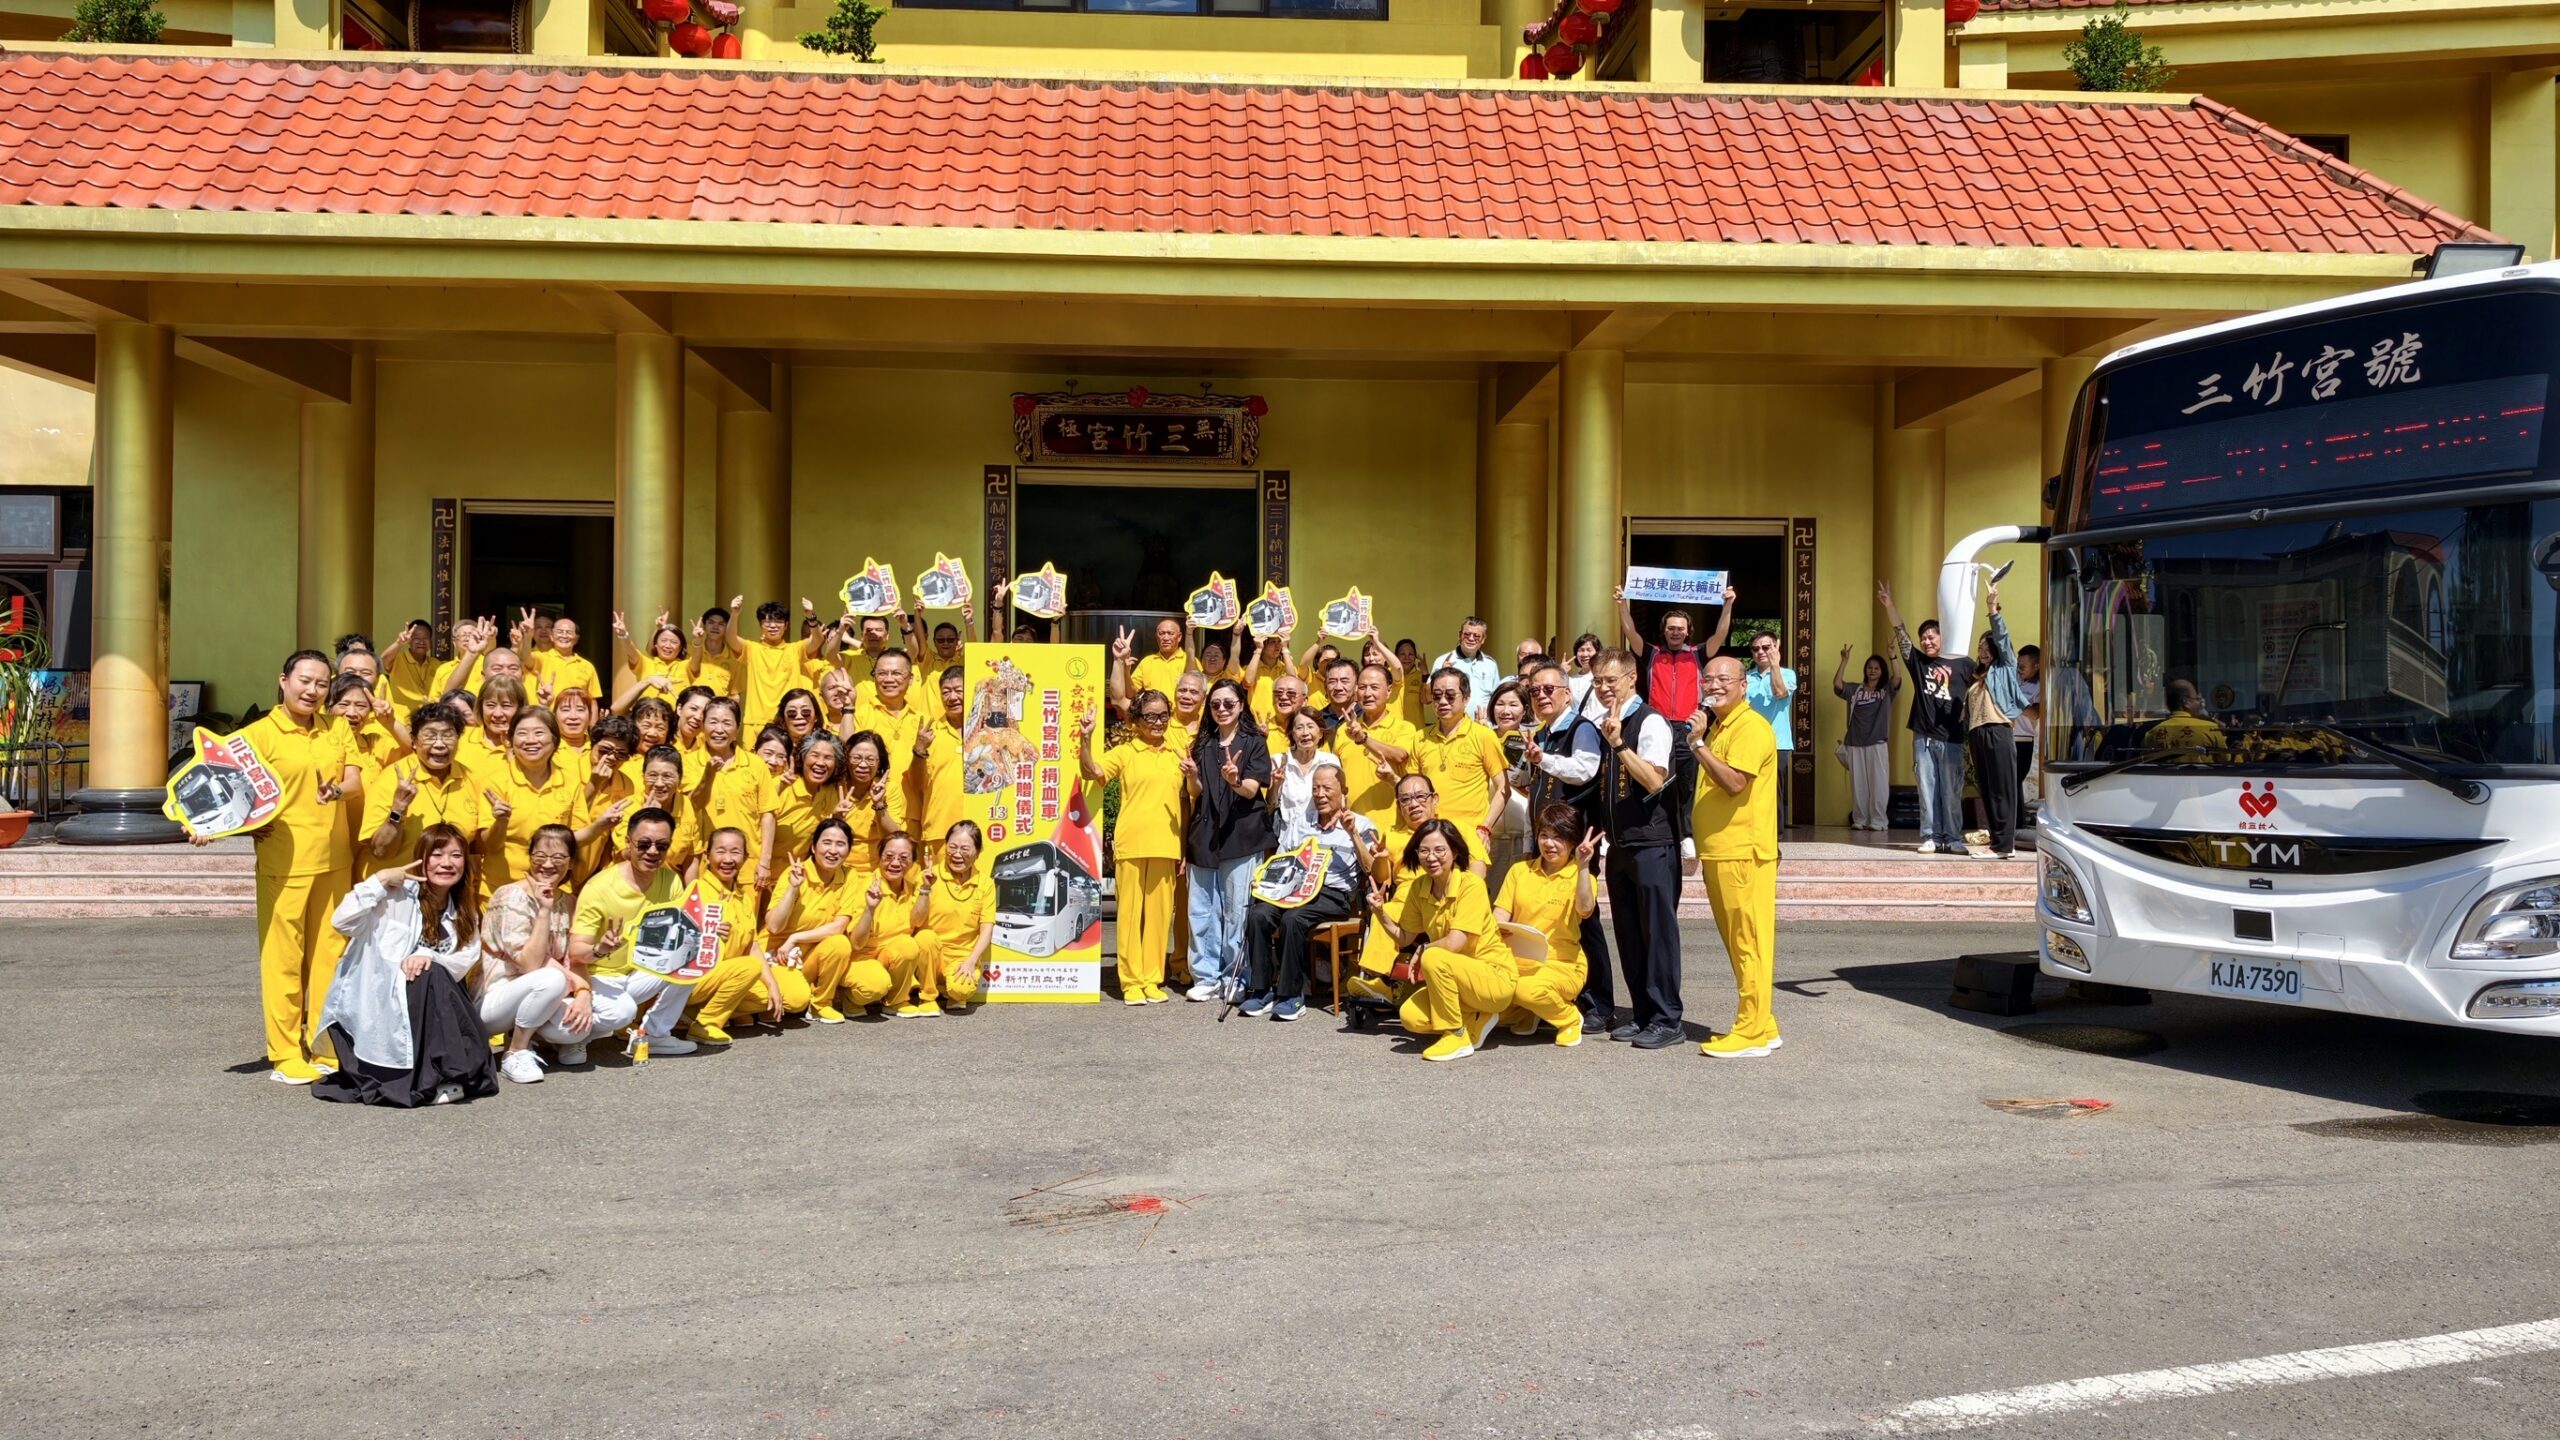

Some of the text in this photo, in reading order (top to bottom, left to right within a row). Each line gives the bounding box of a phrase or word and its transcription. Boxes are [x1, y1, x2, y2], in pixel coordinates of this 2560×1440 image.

[2181, 332, 2423, 415] 三竹宮號
[879, 567, 896, 604] 三竹宮號
[951, 561, 969, 596] 三竹宮號
[1630, 576, 1722, 595] 土城東區扶輪社
[1224, 582, 1237, 618] 三竹宮號
[1278, 590, 1295, 625] 三竹宮號
[228, 737, 277, 798] 三竹宮號
[1041, 690, 1059, 819] 三竹宮號 捐血車
[1015, 764, 1032, 834] 捐贈儀式
[2211, 839, 2301, 867] TYM
[1302, 852, 1325, 895] 三竹宮號
[698, 904, 720, 966] 三竹宮號
[1005, 975, 1079, 984] 新竹捐血中心
